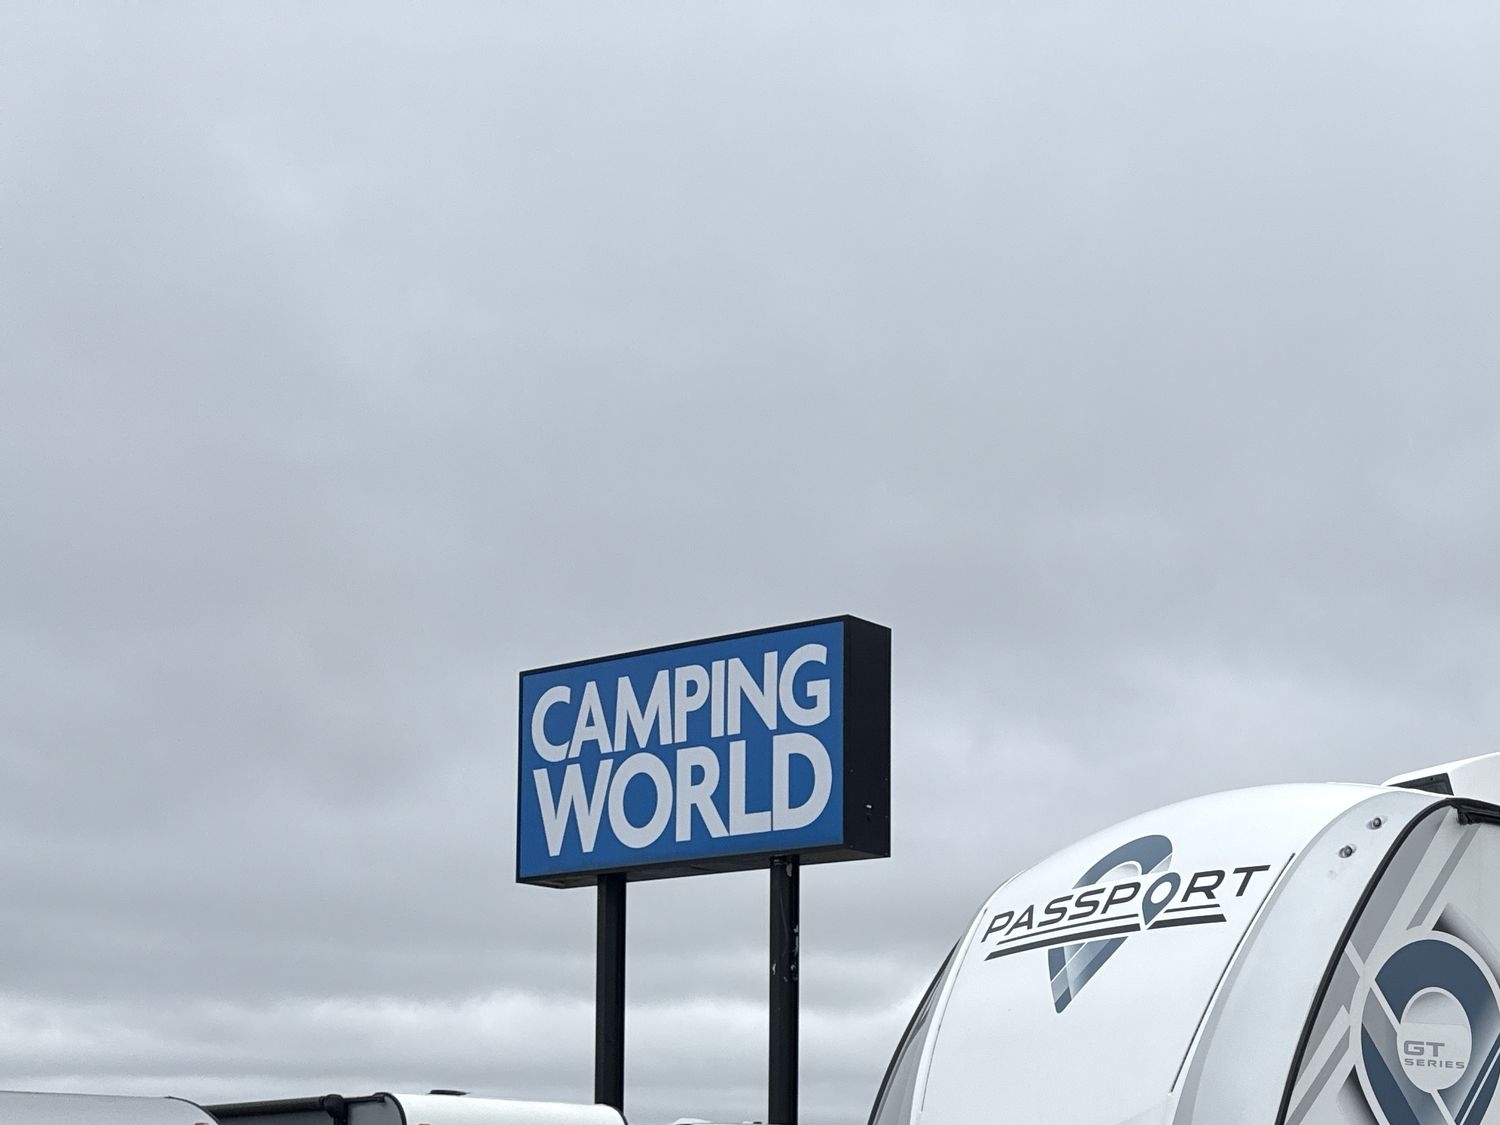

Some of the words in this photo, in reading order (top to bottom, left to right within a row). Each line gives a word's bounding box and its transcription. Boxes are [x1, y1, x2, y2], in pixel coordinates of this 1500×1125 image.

[531, 643, 832, 763] CAMPING
[532, 732, 833, 858] WORLD
[980, 864, 1271, 944] PASSPORT
[1403, 1040, 1445, 1058] GT
[1404, 1058, 1465, 1069] SERIES
